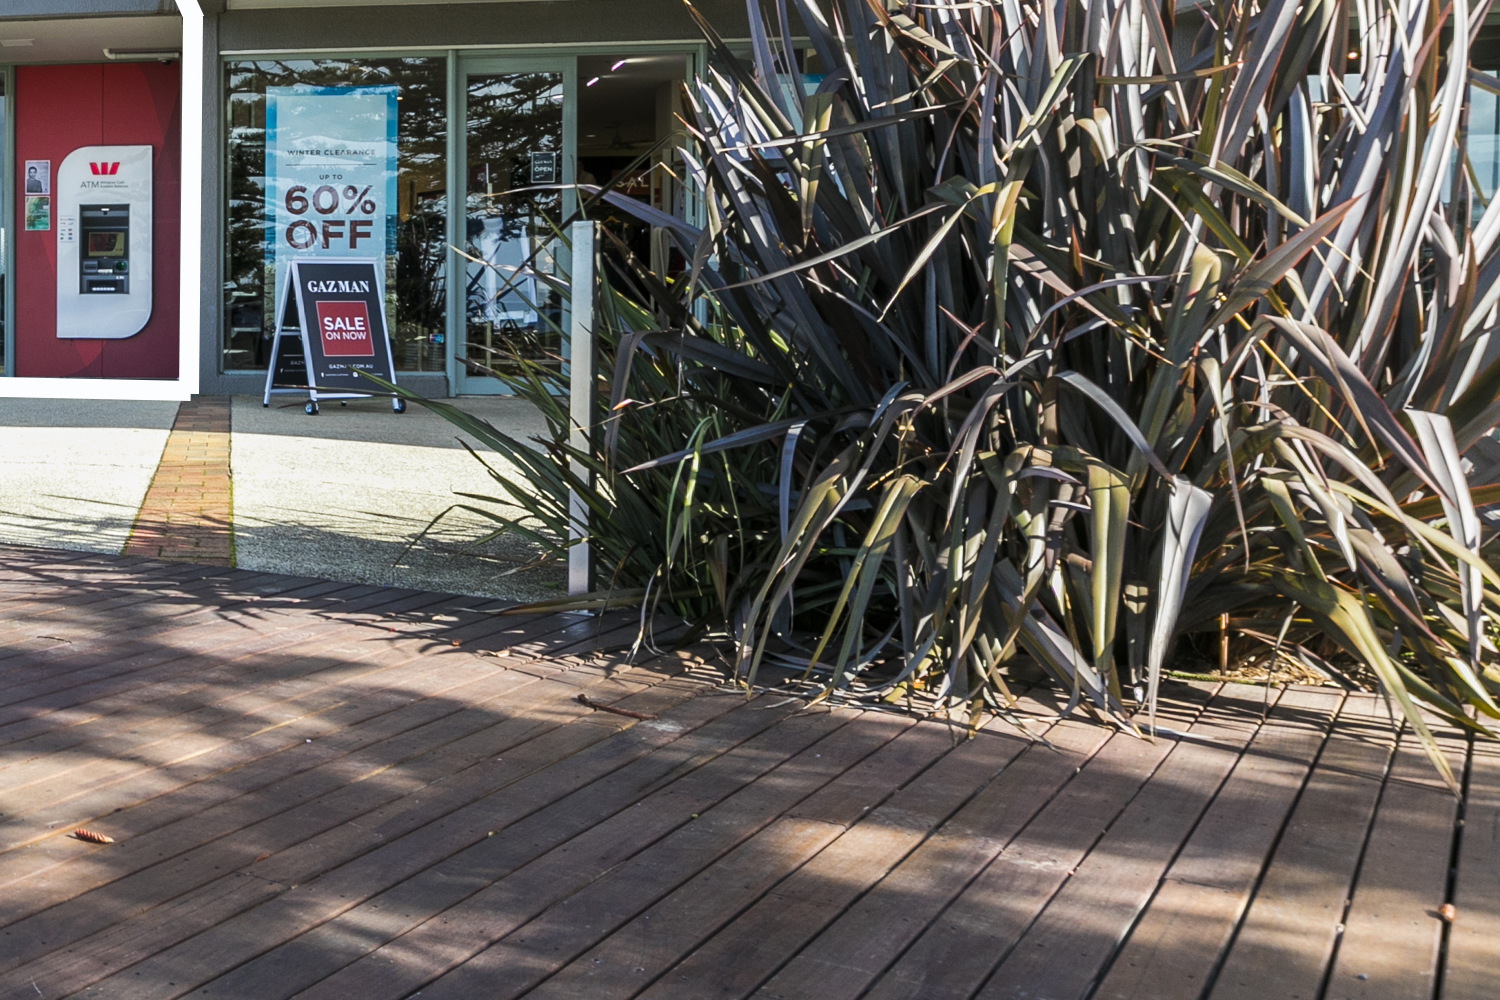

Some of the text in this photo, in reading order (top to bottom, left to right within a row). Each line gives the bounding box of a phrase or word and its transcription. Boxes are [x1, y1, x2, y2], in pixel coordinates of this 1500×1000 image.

[80, 181, 100, 189] ATM
[285, 185, 376, 215] 60%
[285, 220, 373, 249] OFF
[307, 280, 370, 293] GAZMAN
[323, 316, 366, 331] SALE
[325, 331, 367, 340] ON NOW
